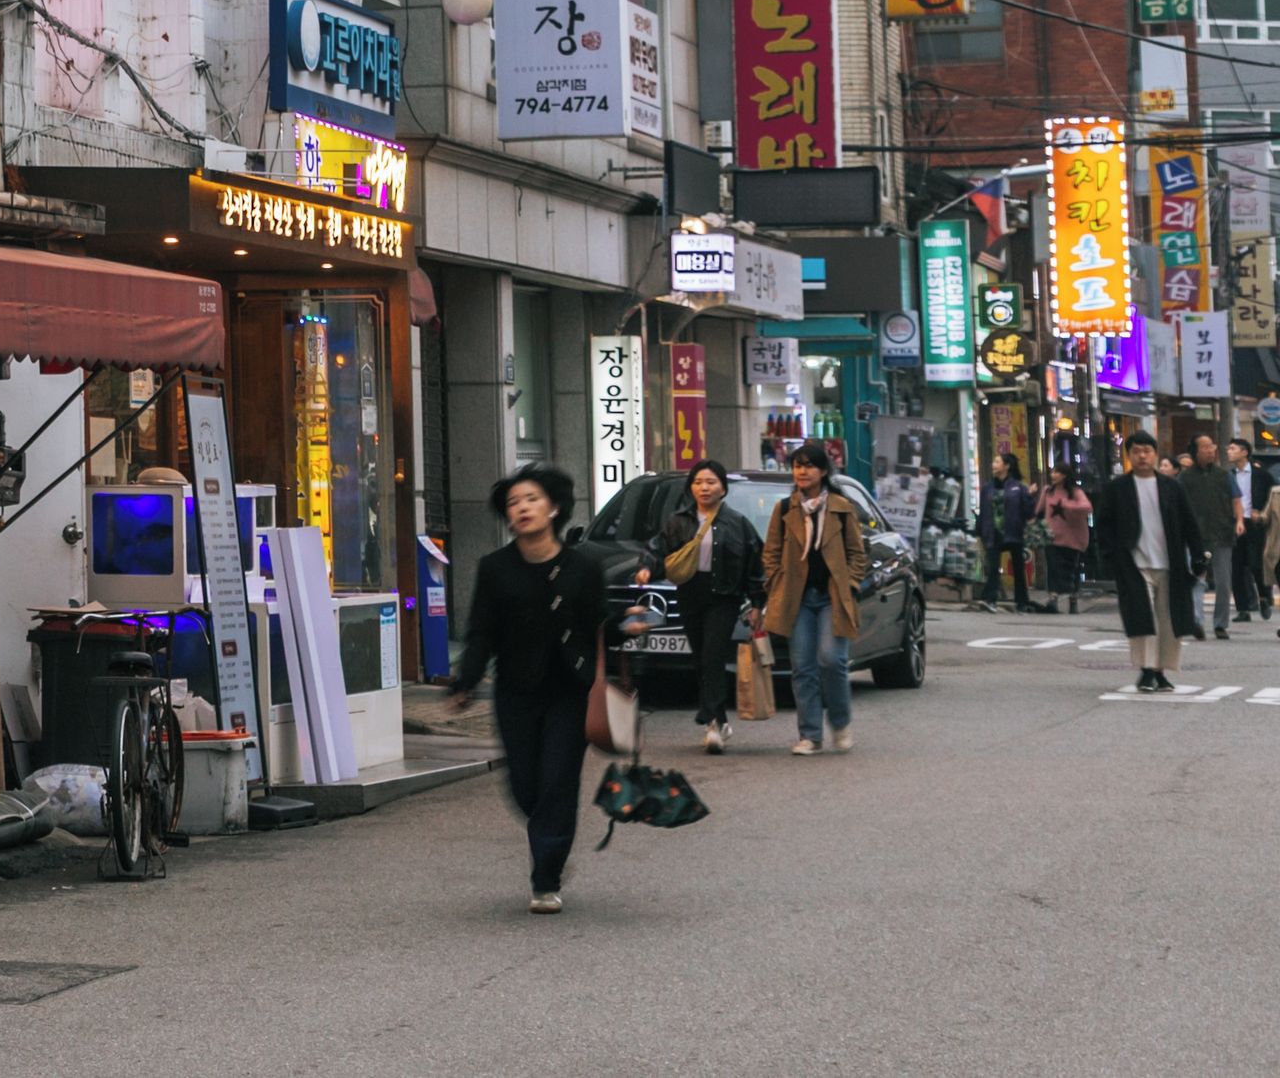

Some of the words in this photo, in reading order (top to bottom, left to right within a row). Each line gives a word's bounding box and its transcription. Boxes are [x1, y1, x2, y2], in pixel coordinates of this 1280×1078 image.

[536, 79, 587, 93] 삼각지점
[515, 96, 609, 115] 794-4774
[1067, 158, 1111, 233] 치킨
[675, 253, 721, 272] 미용실
[944, 256, 965, 306] CZECH
[926, 258, 948, 357] RESTAURANT
[947, 308, 966, 342] PUB
[752, 341, 785, 361] 국밥
[948, 344, 967, 359] &
[649, 636, 687, 652] 0987
